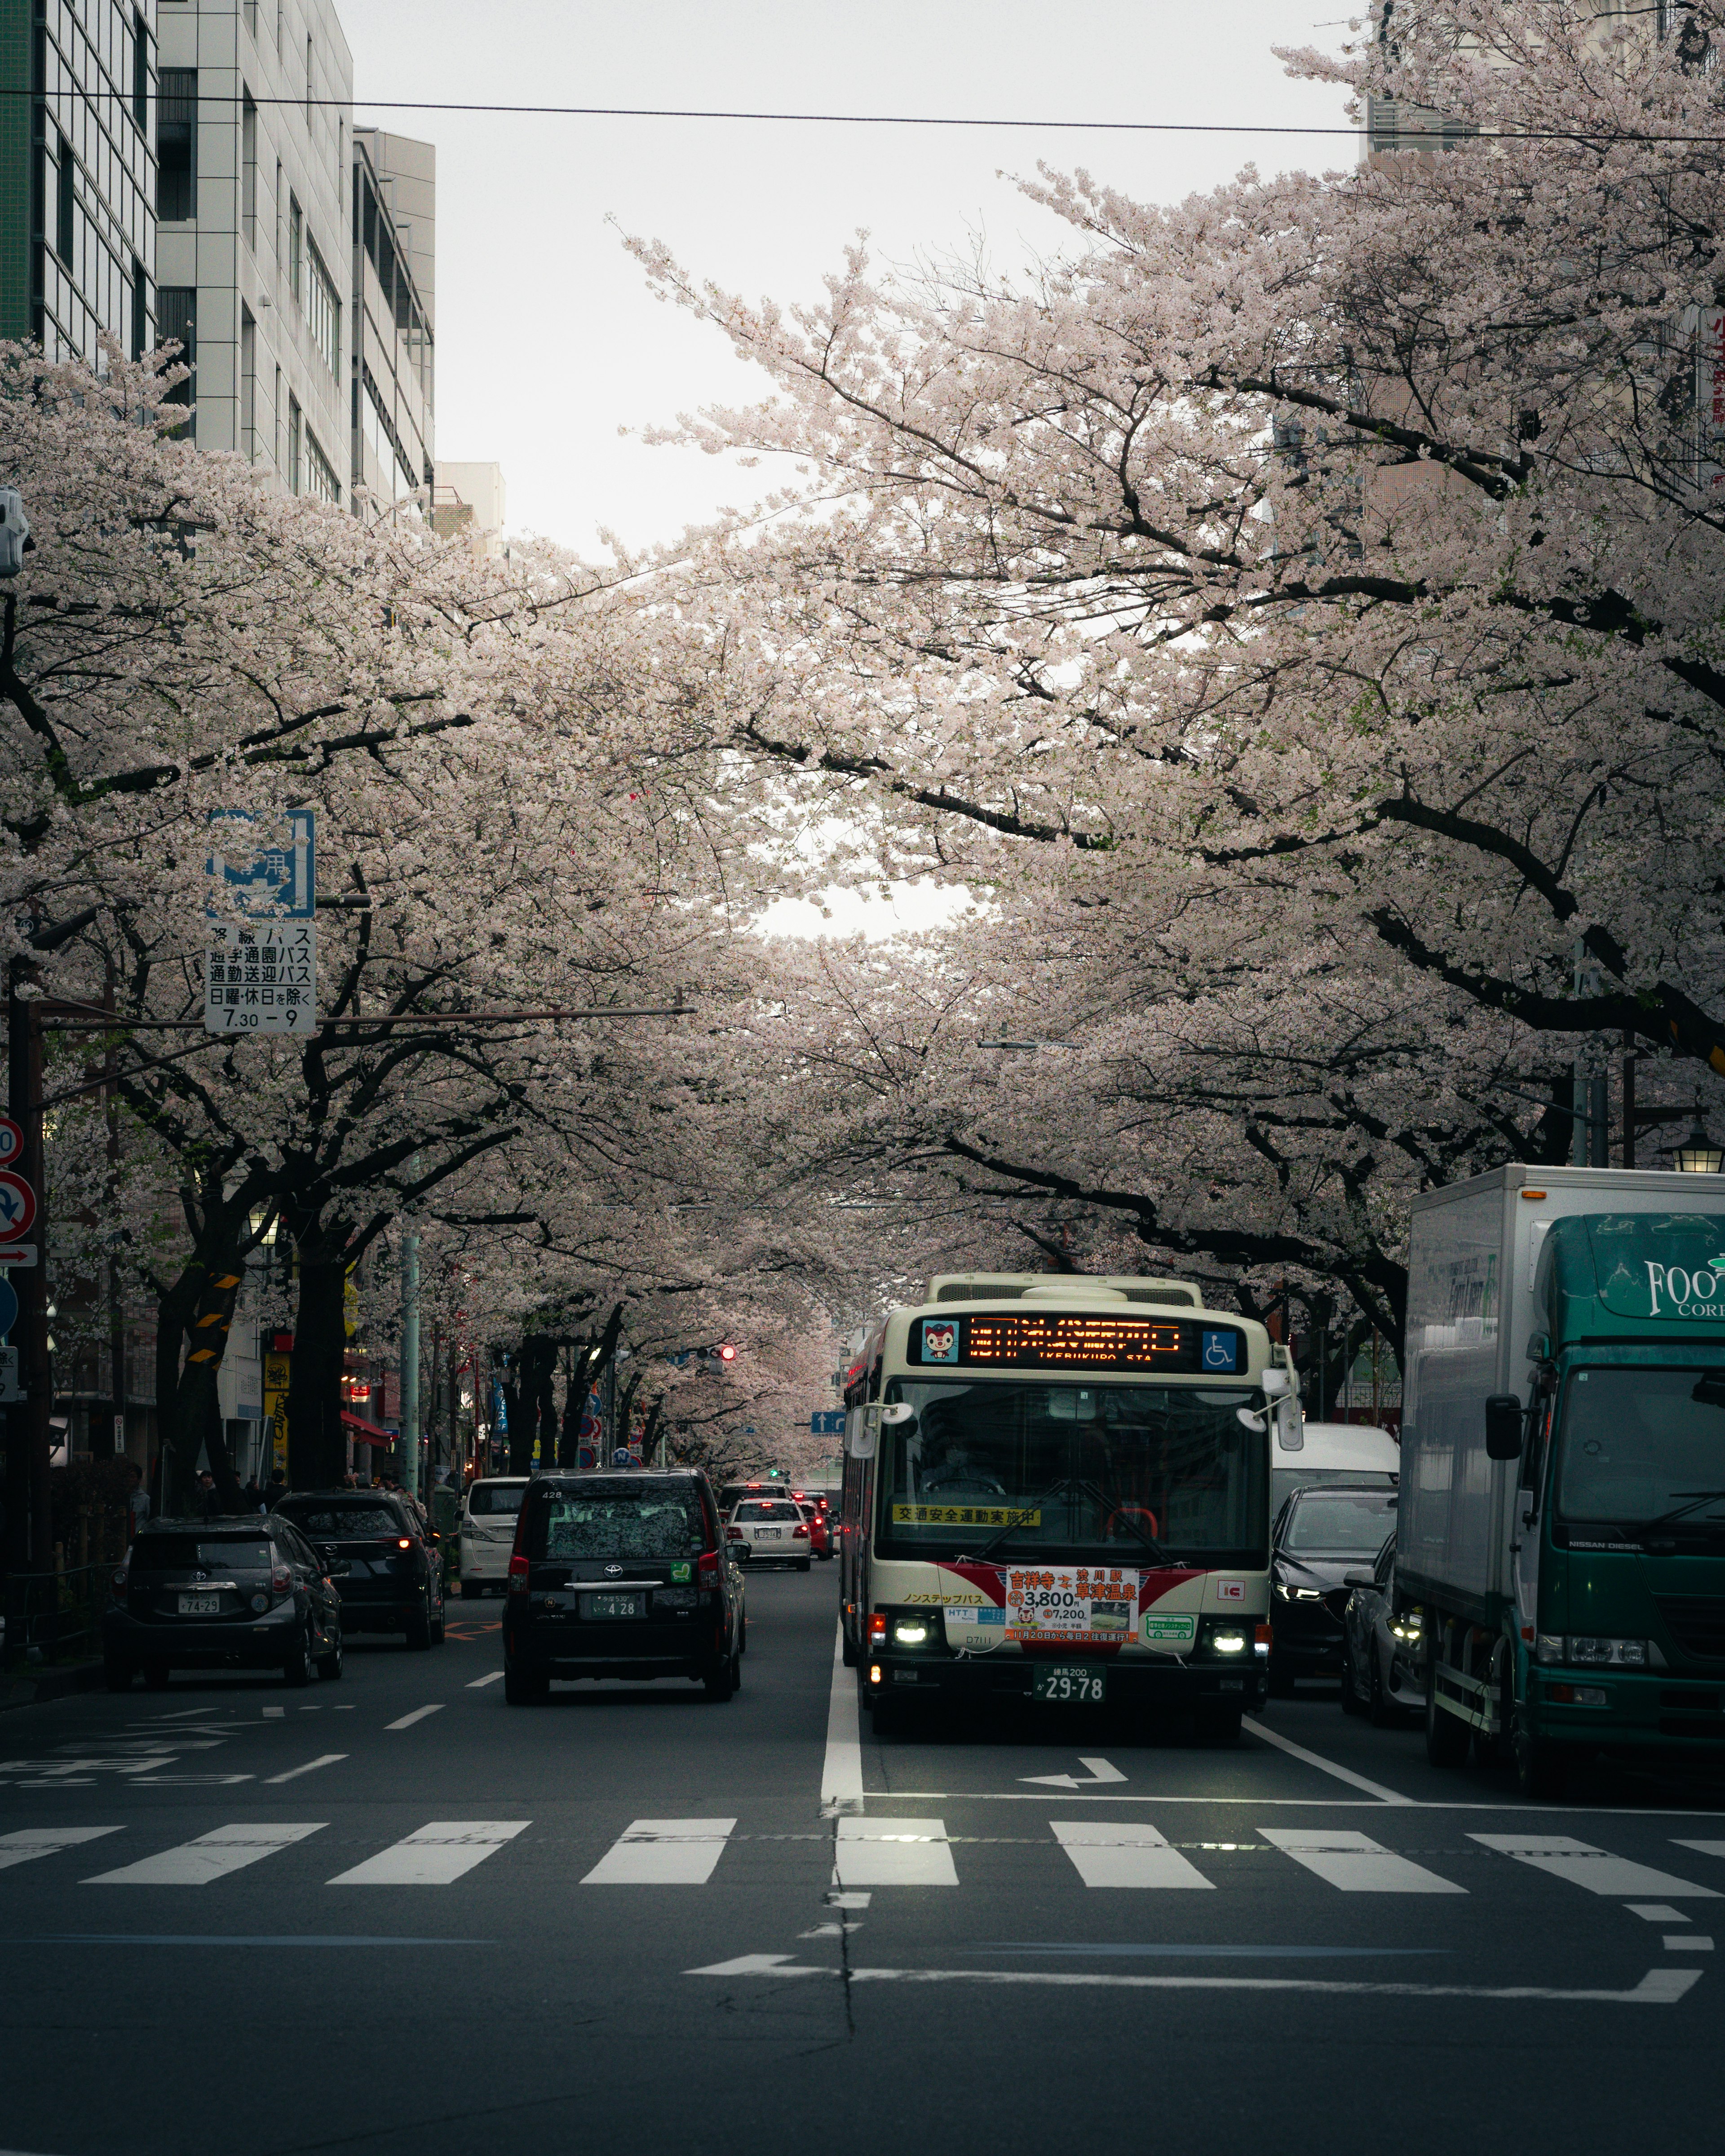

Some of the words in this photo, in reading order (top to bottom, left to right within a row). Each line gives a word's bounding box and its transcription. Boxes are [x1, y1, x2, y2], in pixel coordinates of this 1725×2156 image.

[210, 965, 310, 983] 通勤送迎バス
[211, 988, 310, 1006] 日曜・休日を除く
[899, 1507, 1034, 1524] 交通安全運動実施中
[1009, 1570, 1055, 1590] 吉祥寺
[1076, 1568, 1123, 1582] 渋川駅
[1075, 1582, 1137, 1601] 草津温泉
[187, 1601, 217, 1612] 74-29
[904, 1594, 983, 1608] ノンステップバス
[967, 1636, 991, 1649] D7111
[1046, 1677, 1102, 1700] 29-78
